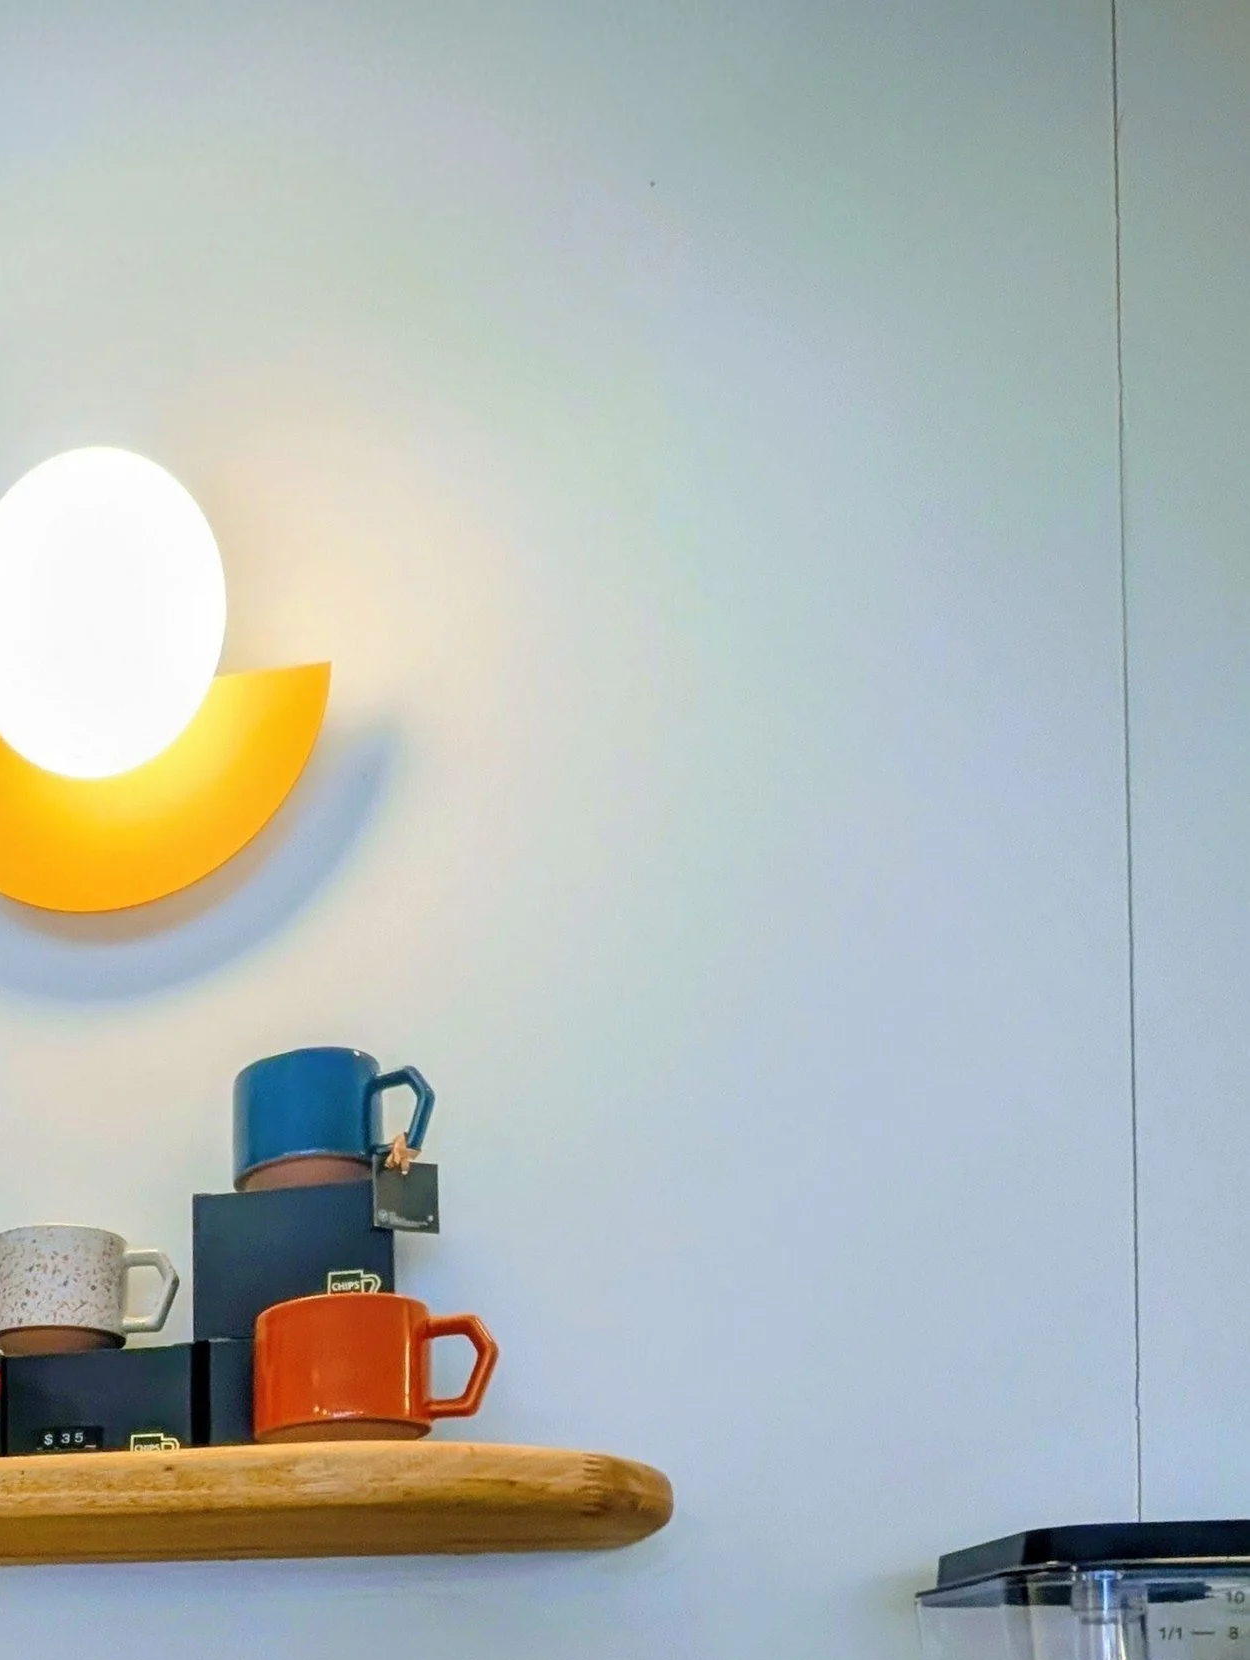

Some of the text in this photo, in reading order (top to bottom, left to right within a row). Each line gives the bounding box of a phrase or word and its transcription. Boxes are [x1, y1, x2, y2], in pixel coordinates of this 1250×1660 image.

[331, 1280, 361, 1292] CHIPS
[1158, 1626, 1239, 1640] 1/1 8
